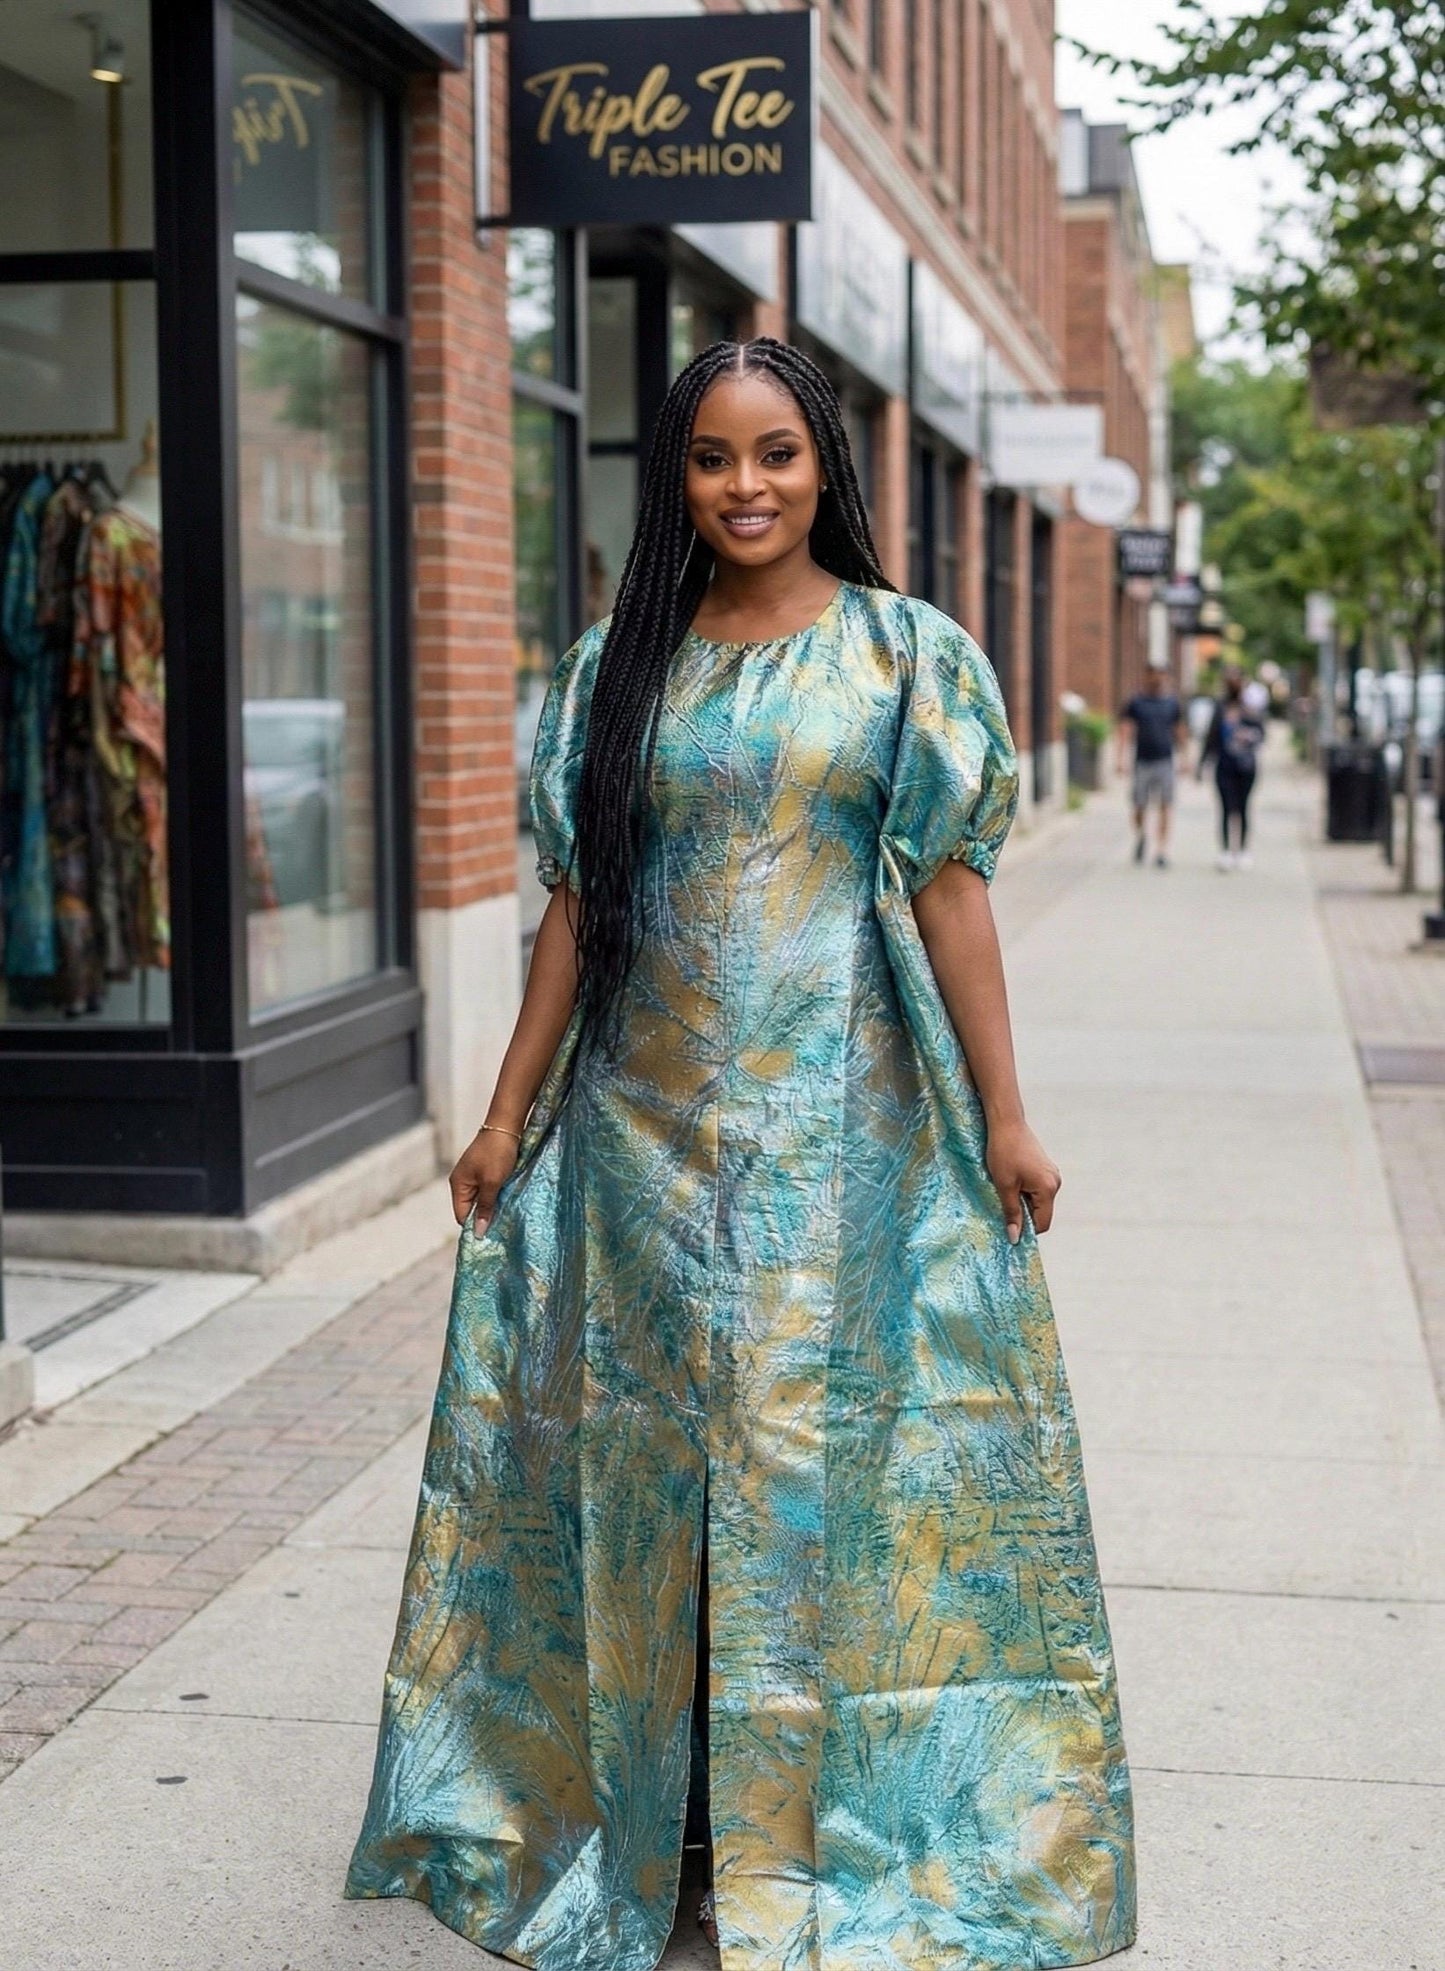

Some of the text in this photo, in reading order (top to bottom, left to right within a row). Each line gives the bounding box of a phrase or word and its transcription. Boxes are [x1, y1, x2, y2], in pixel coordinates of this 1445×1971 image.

[524, 56, 794, 159] Triple Tee
[609, 142, 782, 178] FASHION
